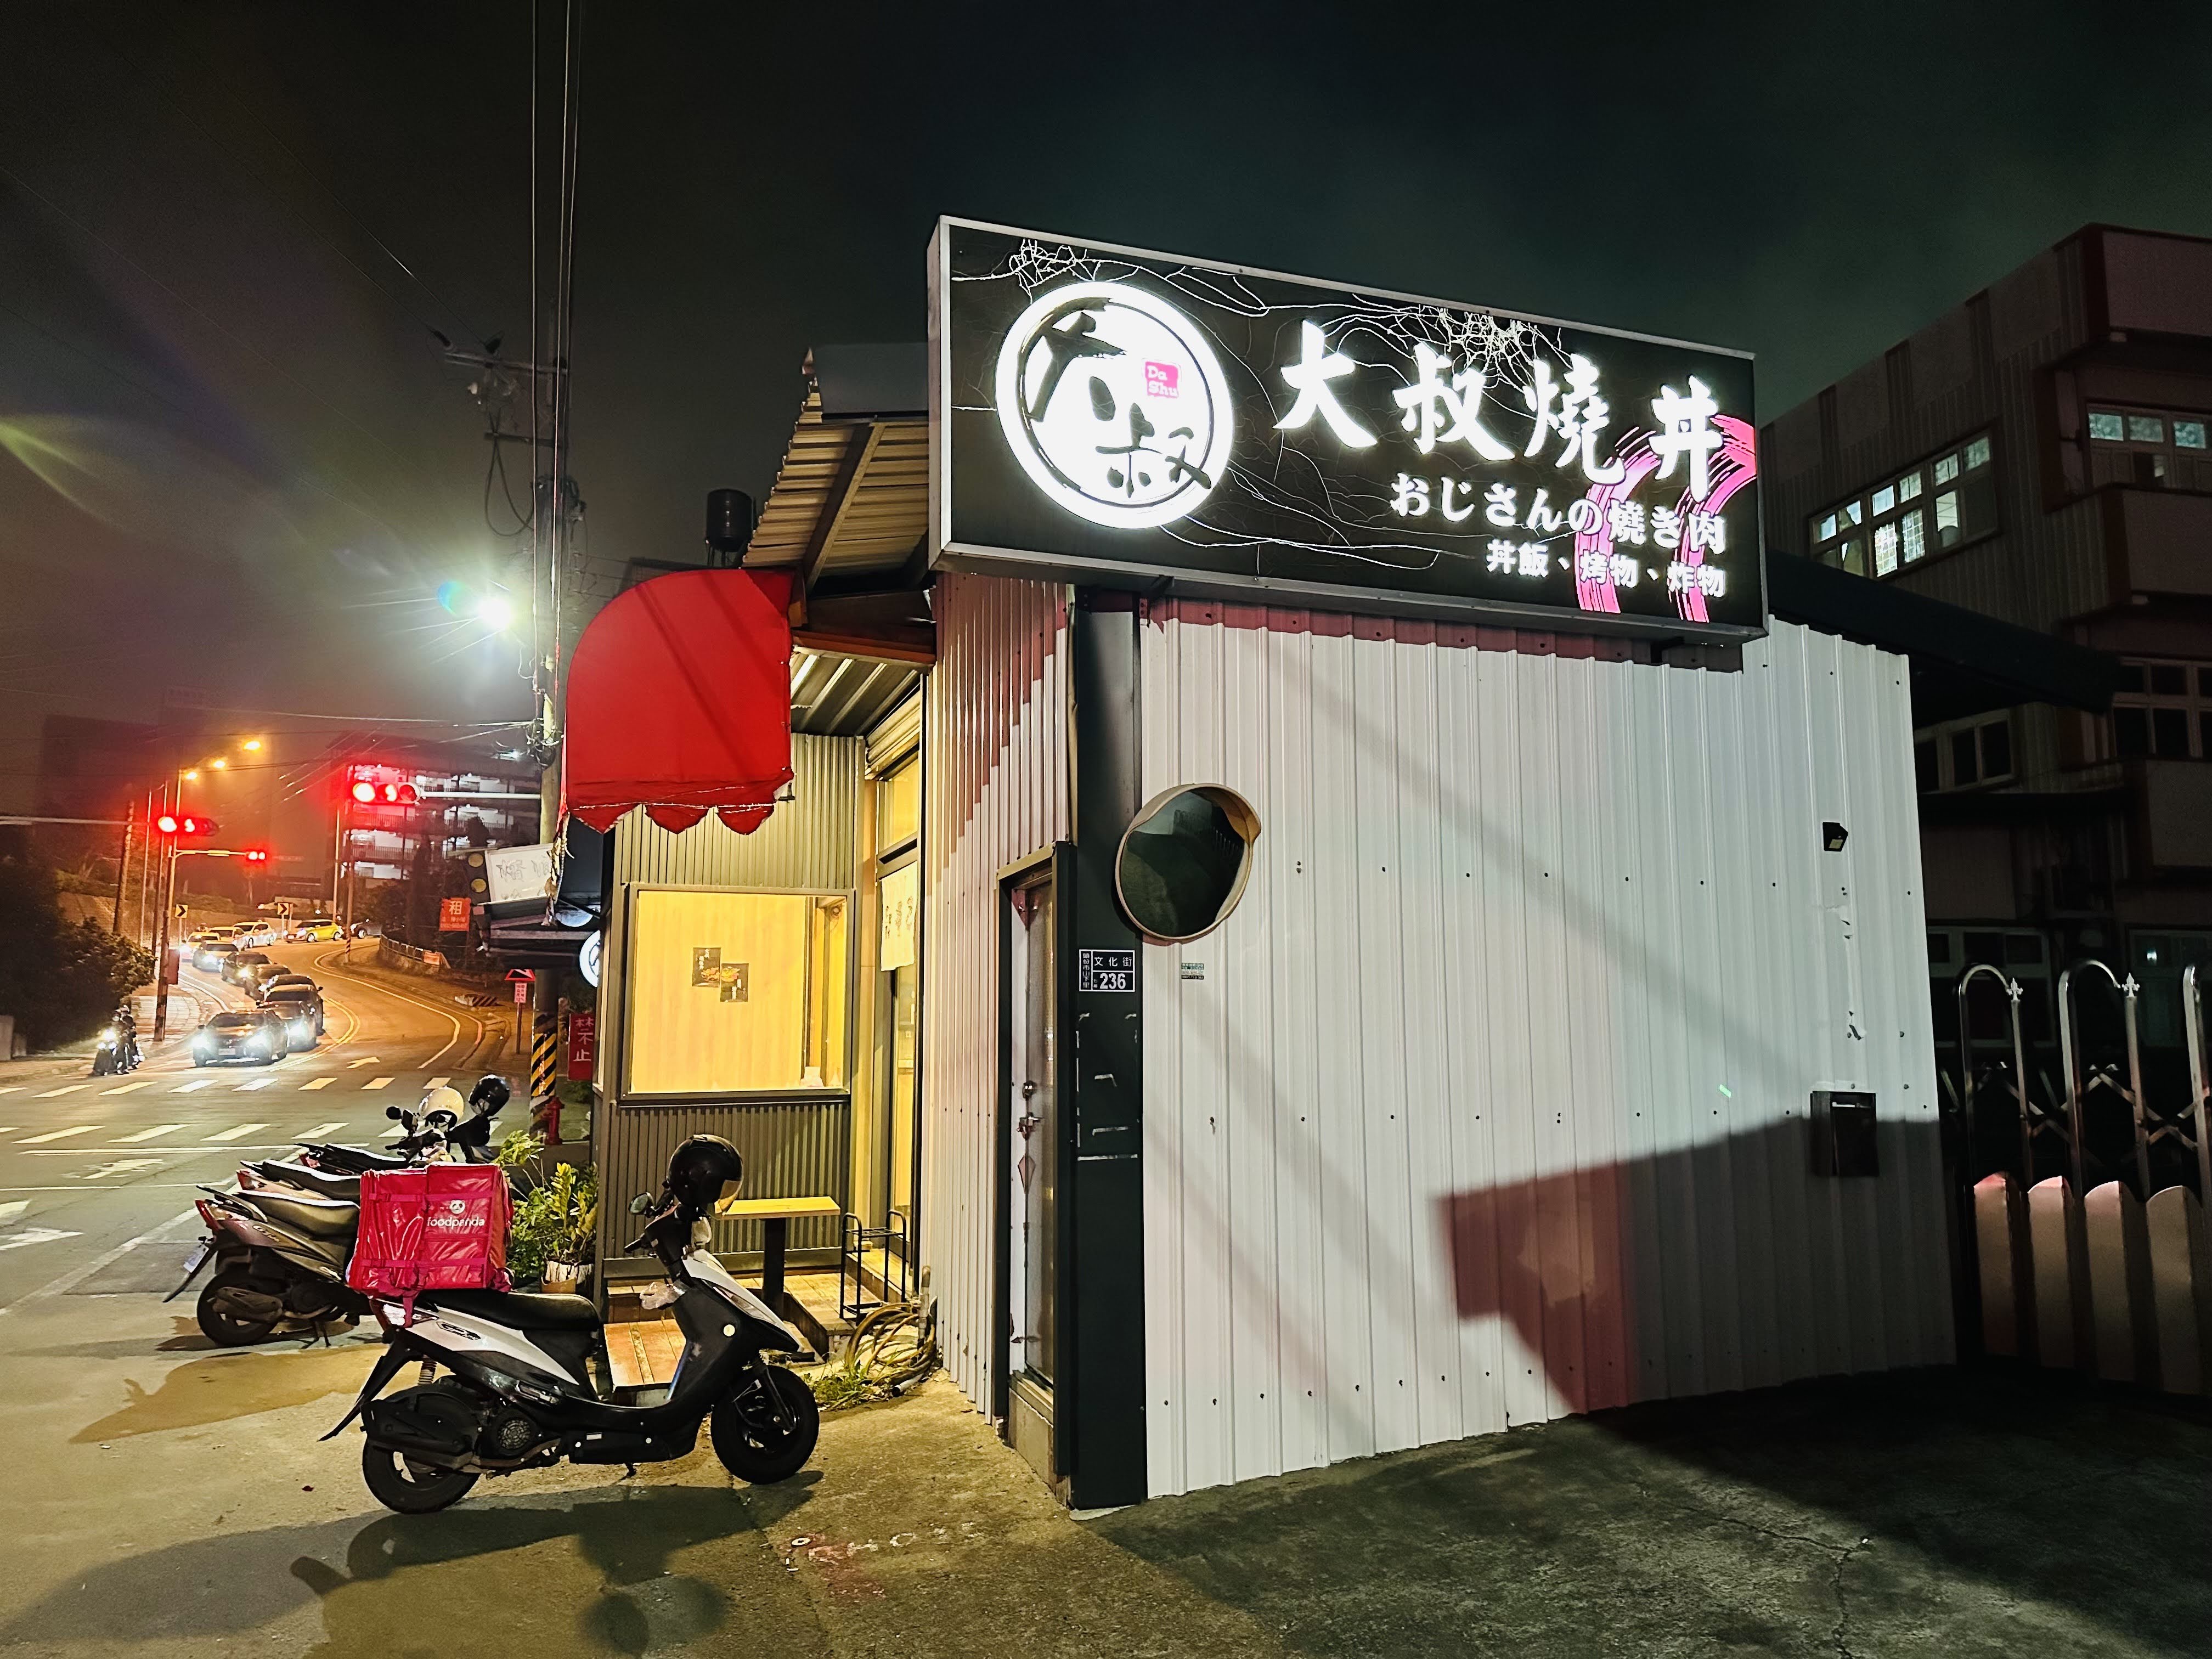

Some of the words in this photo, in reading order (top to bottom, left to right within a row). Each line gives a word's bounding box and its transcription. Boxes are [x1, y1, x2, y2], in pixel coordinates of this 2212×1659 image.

[1147, 365, 1168, 380] Da
[1148, 381, 1177, 397] Shu
[1273, 320, 1723, 502] 大叔燒丼
[1486, 539, 1725, 598] 丼飯、烤物、炸物
[449, 900, 462, 915] 租
[1094, 956, 1132, 967] 文化街
[1099, 973, 1126, 990] 236
[573, 1017, 594, 1062] 禁止
[427, 1216, 485, 1228] foodpanda
